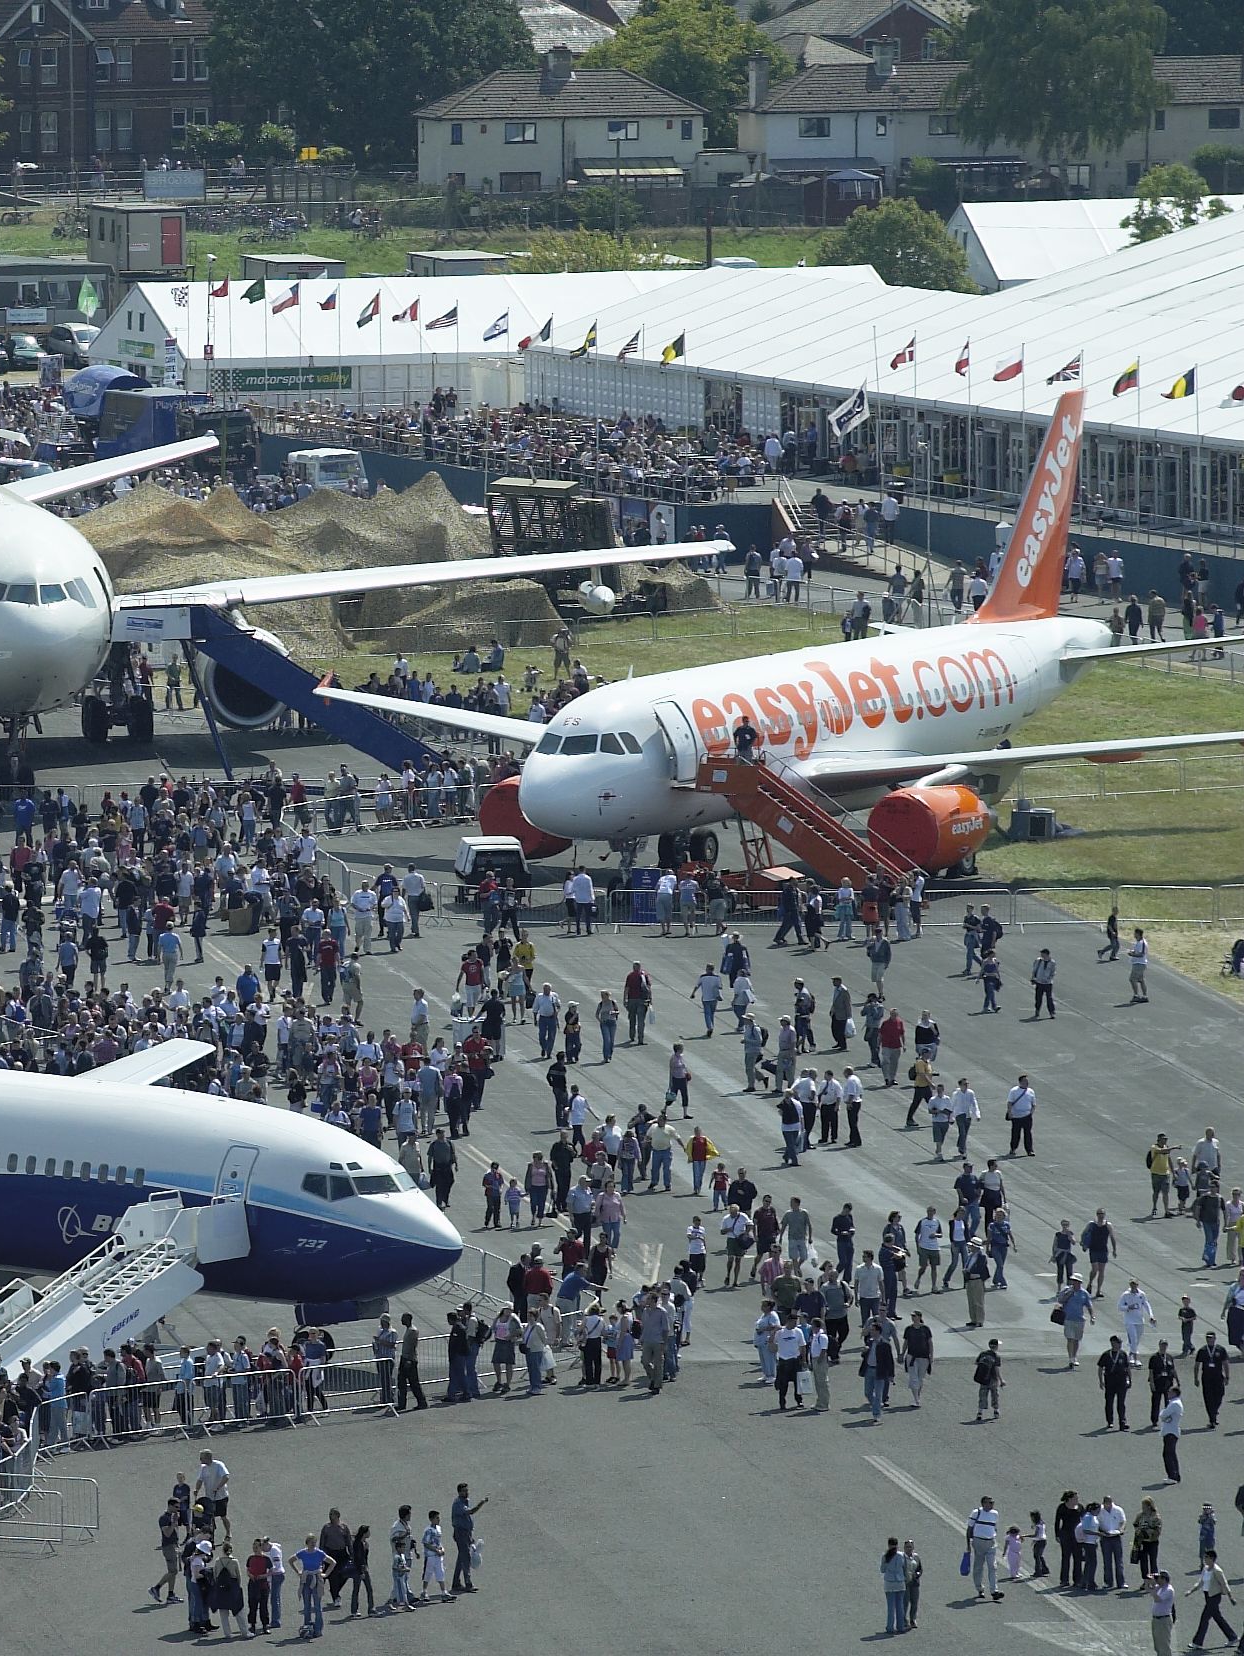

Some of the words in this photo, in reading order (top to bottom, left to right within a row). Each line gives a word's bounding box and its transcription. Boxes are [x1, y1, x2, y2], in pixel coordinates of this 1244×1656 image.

[246, 373, 314, 387] motorsport
[316, 371, 349, 385] valley
[1016, 414, 1076, 588] easyJet
[692, 649, 1014, 761] easyJet.com
[952, 816, 983, 834] easyJet
[296, 1237, 328, 1250] 737
[110, 1308, 141, 1336] BOEING
